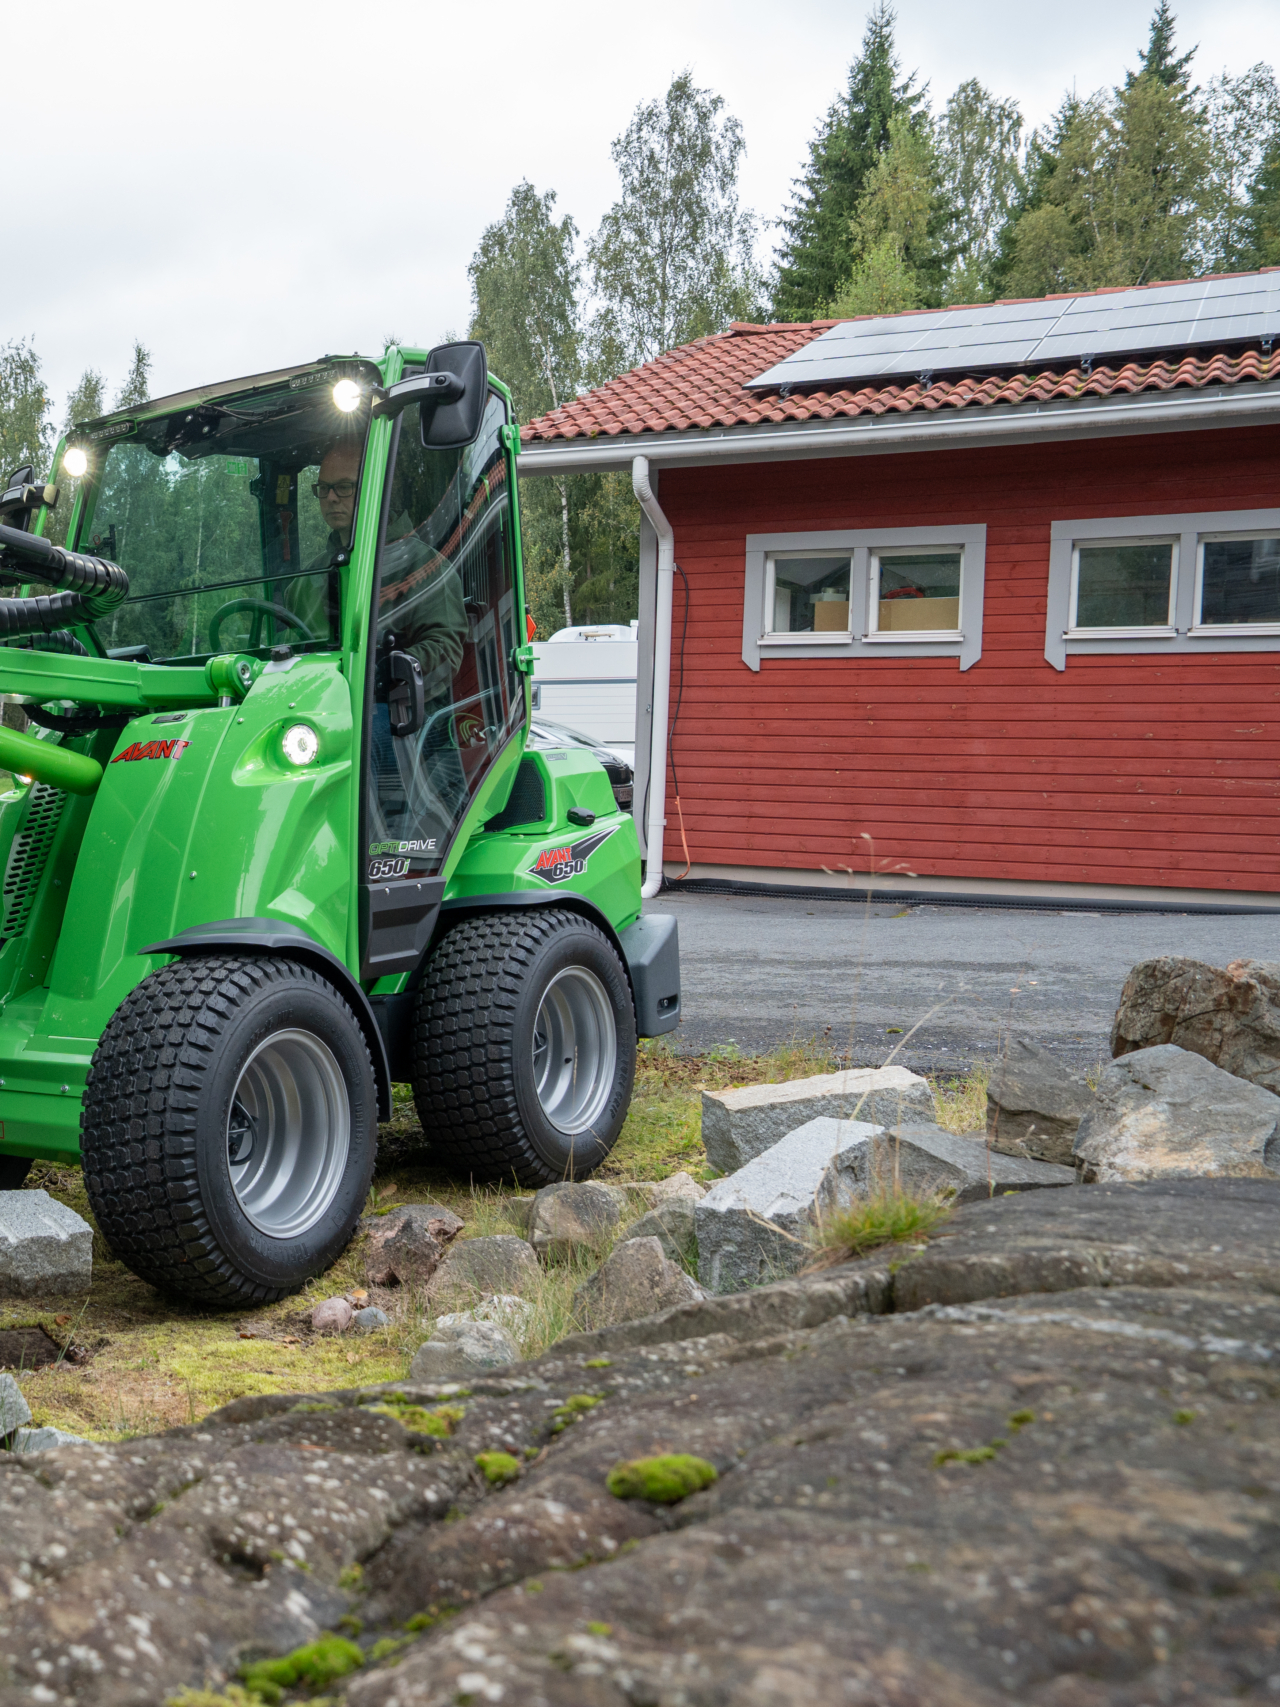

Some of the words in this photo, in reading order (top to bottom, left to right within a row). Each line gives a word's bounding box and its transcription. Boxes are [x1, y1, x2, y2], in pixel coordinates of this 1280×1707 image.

[109, 739, 193, 763] AVANT
[369, 839, 436, 855] OPTIDRIVE
[368, 858, 411, 879] 650i
[534, 846, 572, 871] AVANT
